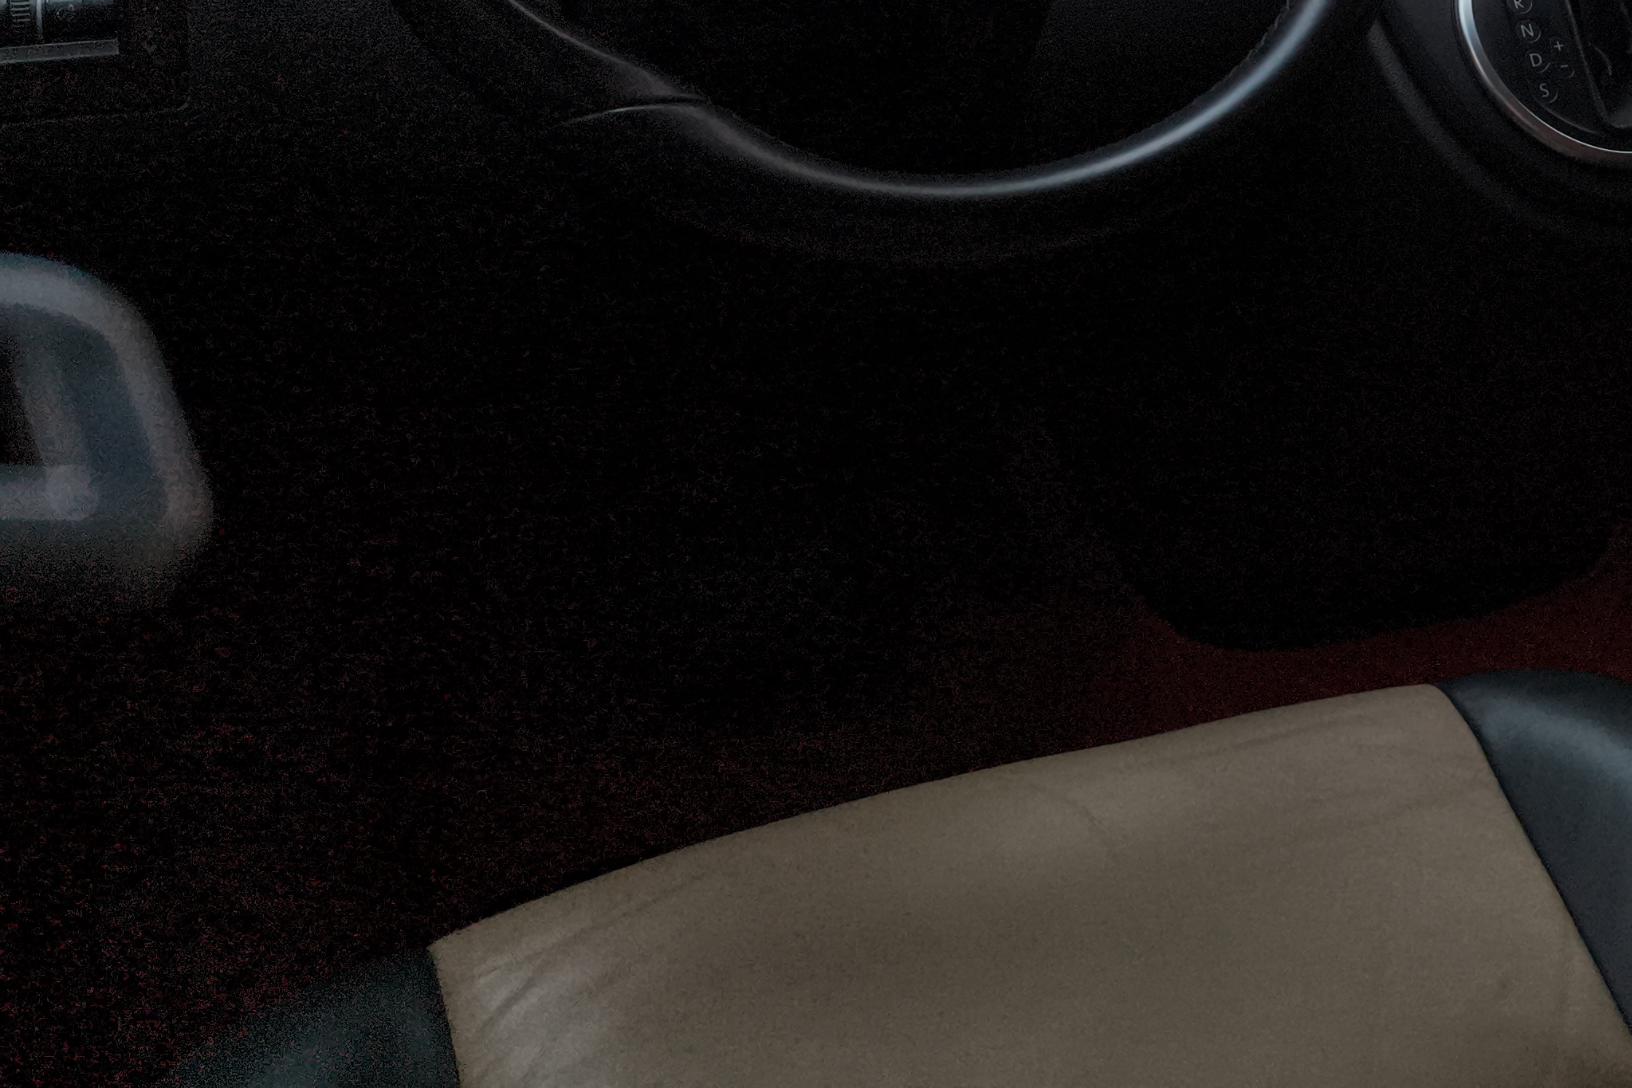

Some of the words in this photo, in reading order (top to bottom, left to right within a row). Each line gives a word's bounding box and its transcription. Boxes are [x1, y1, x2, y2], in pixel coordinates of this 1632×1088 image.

[1520, 23, 1535, 38] N
[1529, 52, 1543, 68] D
[1539, 82, 1550, 98] S
